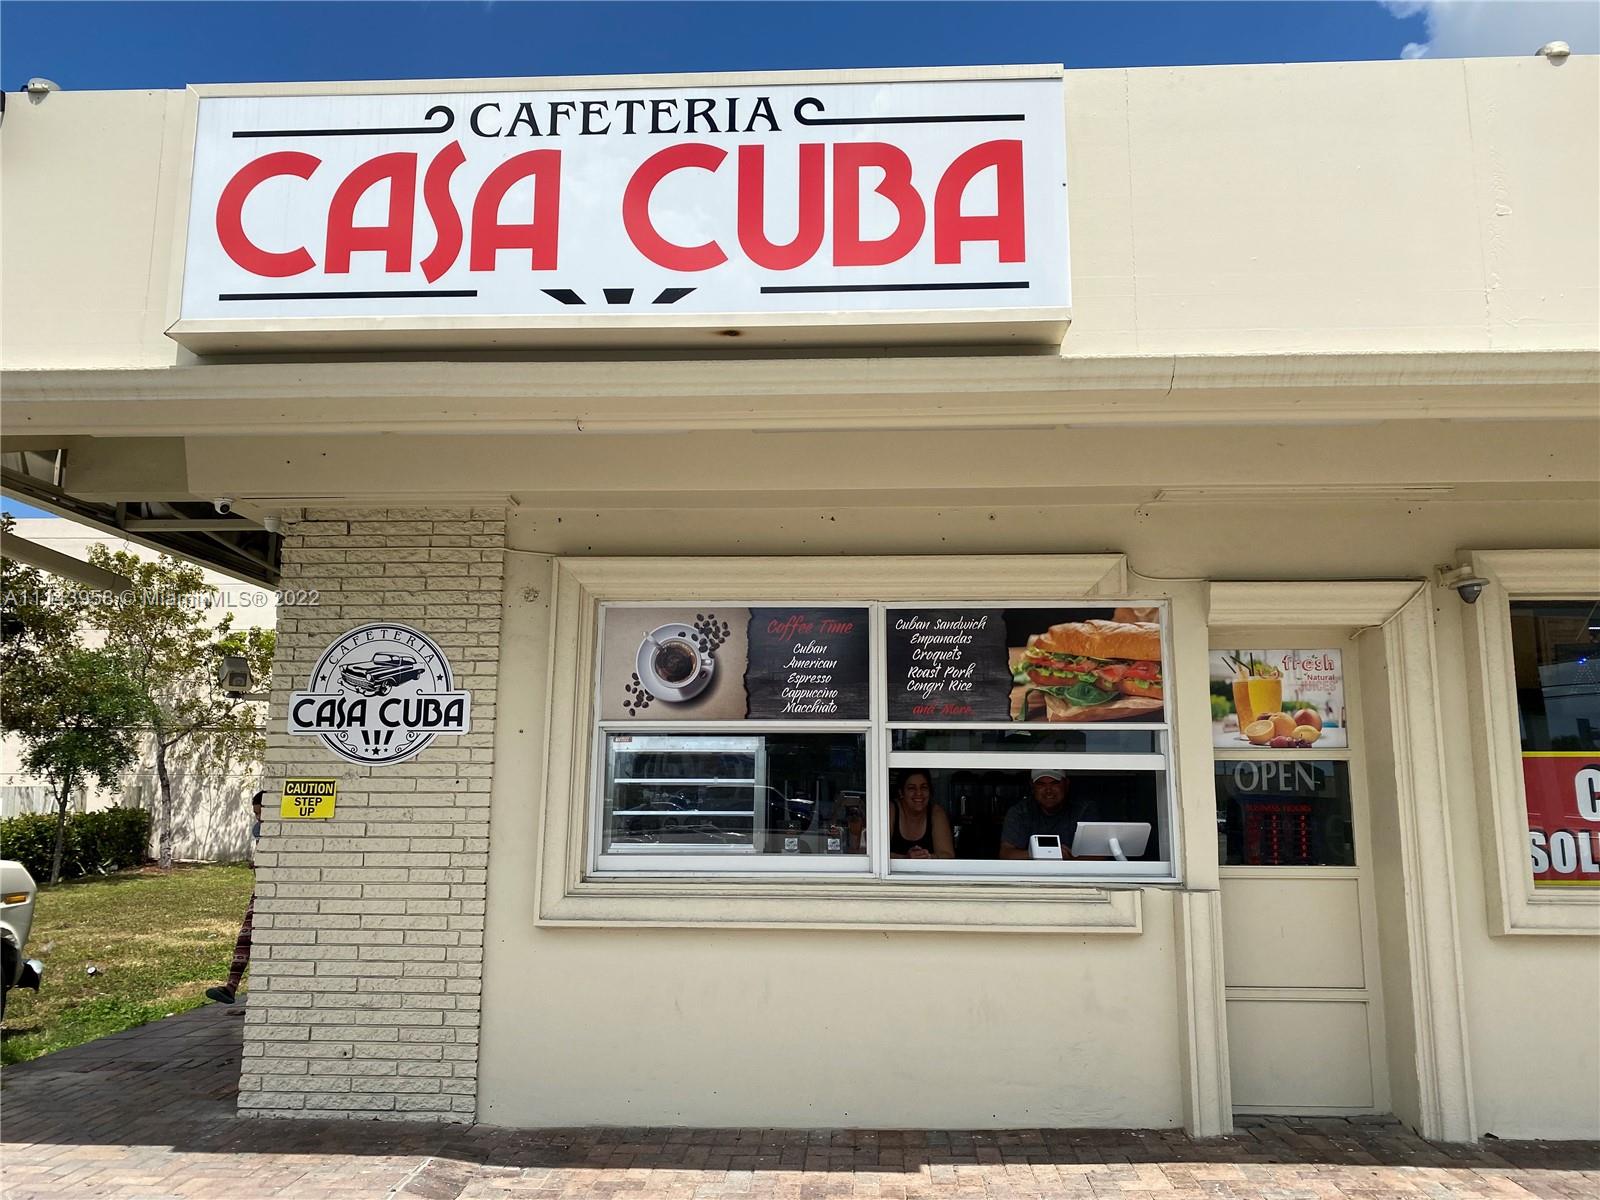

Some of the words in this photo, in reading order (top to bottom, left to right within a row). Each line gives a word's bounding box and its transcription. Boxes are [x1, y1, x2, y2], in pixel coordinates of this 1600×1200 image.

[470, 97, 782, 137] CAFETERIA
[215, 140, 562, 284] CASA
[622, 139, 1026, 272] CUBA
[767, 614, 815, 641] Coffee
[819, 619, 855, 634] Time
[895, 615, 931, 630] Cuban
[933, 615, 988, 630] Sandwich
[328, 629, 436, 665] CAFETERIA
[793, 639, 828, 654] Cuban
[910, 630, 973, 650] Empanadas
[783, 655, 838, 669] American
[912, 645, 962, 667] Croquets
[1282, 654, 1335, 672] fresh
[907, 663, 942, 679] Roast
[943, 662, 977, 679] Pork
[787, 672, 833, 689] Espresso
[906, 679, 946, 700] Congri
[948, 679, 973, 692] Rice
[781, 687, 839, 704] Cappuccino
[292, 697, 367, 729] CASA
[379, 698, 465, 728] CUBA
[781, 698, 838, 713] Macchiato
[1234, 761, 1316, 792] OPEN
[286, 782, 334, 795] CAUTION
[294, 797, 323, 807] STEP
[299, 807, 315, 817] UP
[1529, 831, 1600, 874] SOL
